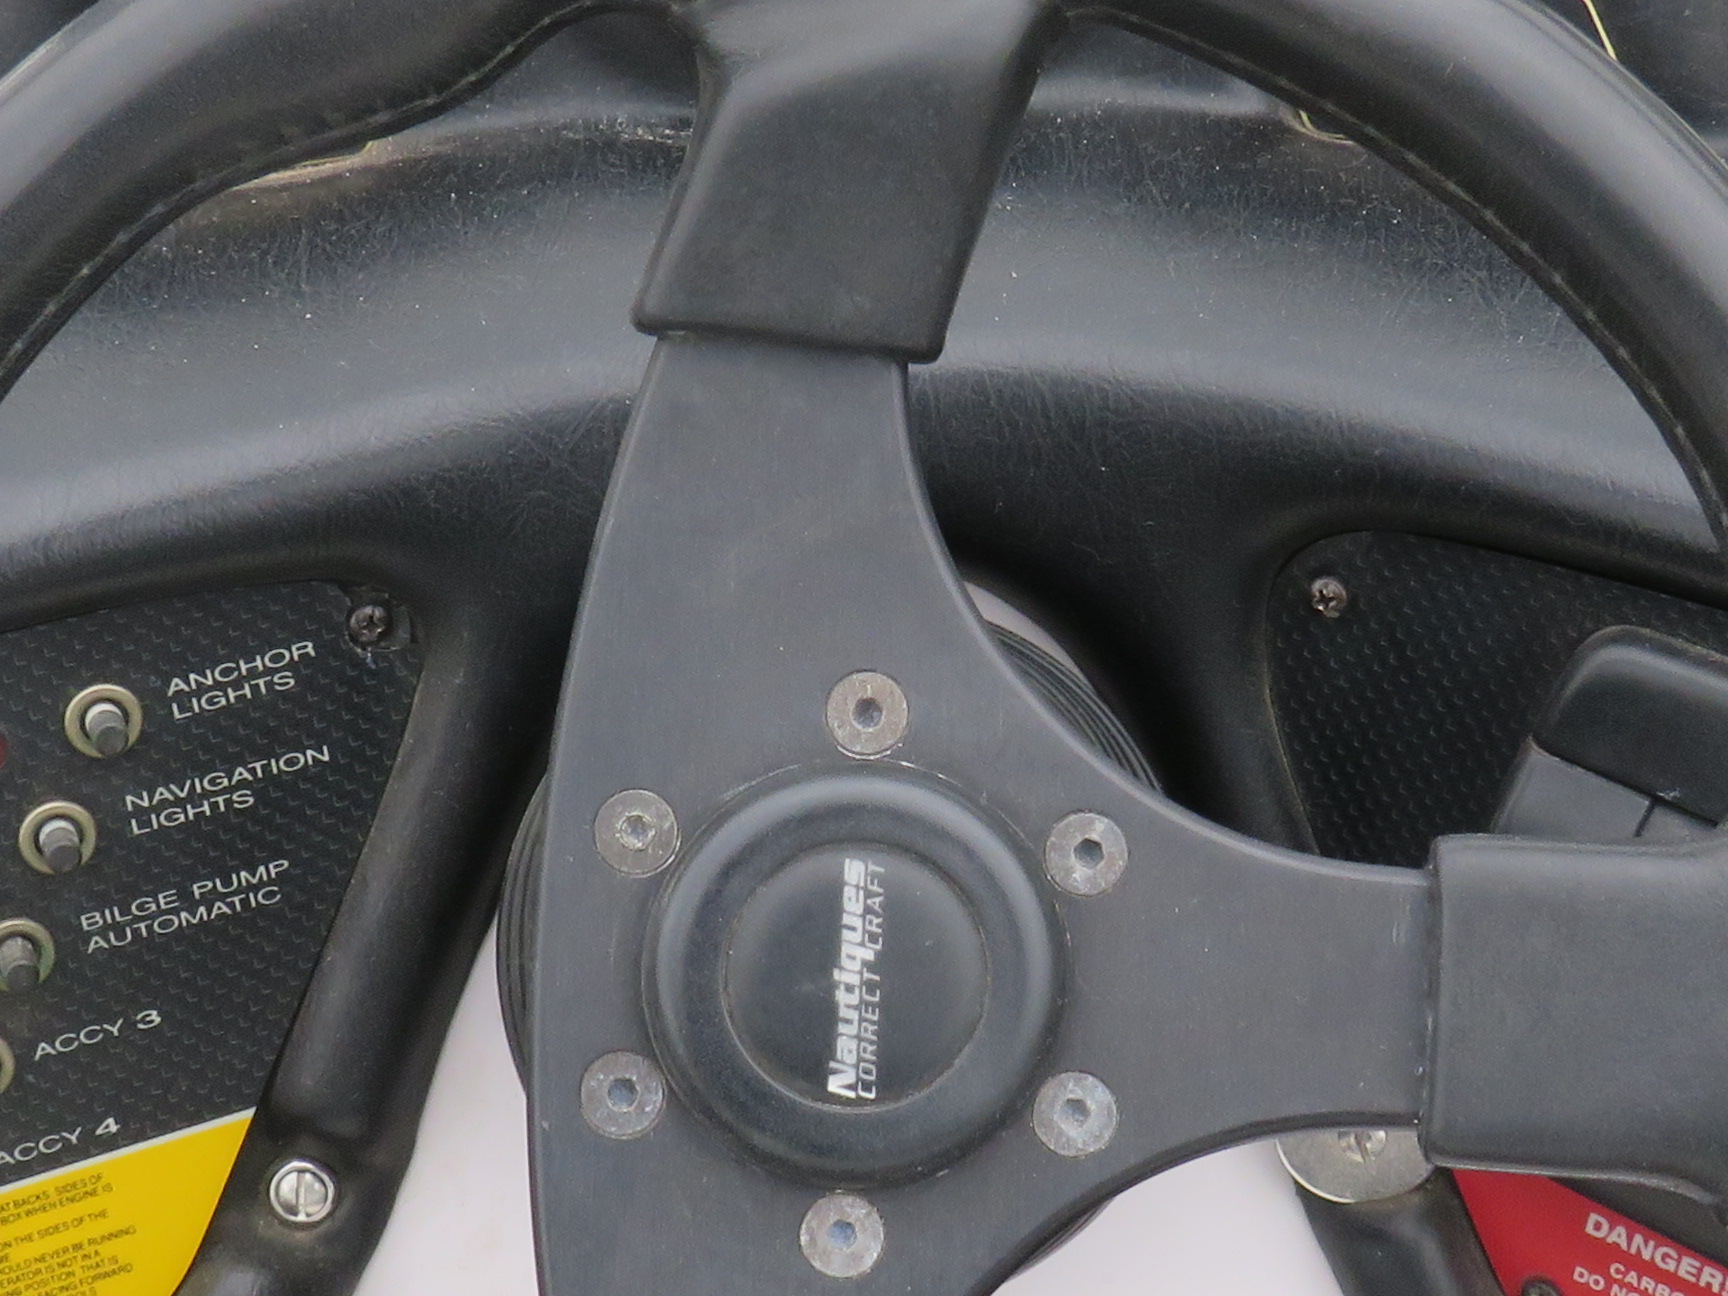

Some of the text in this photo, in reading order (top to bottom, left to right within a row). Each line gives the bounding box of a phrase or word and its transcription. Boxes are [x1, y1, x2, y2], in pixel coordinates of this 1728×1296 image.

[167, 641, 316, 697] ANCHOR
[172, 671, 295, 721] LIGHTS
[126, 745, 331, 812] NAVIGATION
[131, 789, 256, 836] LIGHTS
[81, 859, 290, 932] BILGE PUMP
[87, 885, 282, 954] AUTOMATIC
[827, 858, 875, 1100] Nautiques
[856, 861, 886, 1100] CORRECT CRAFT
[34, 1010, 162, 1061] ACCY 3
[95, 1117, 120, 1137] 4
[54, 1178, 87, 1196] SIDES
[1573, 1266, 1605, 1290] DO
